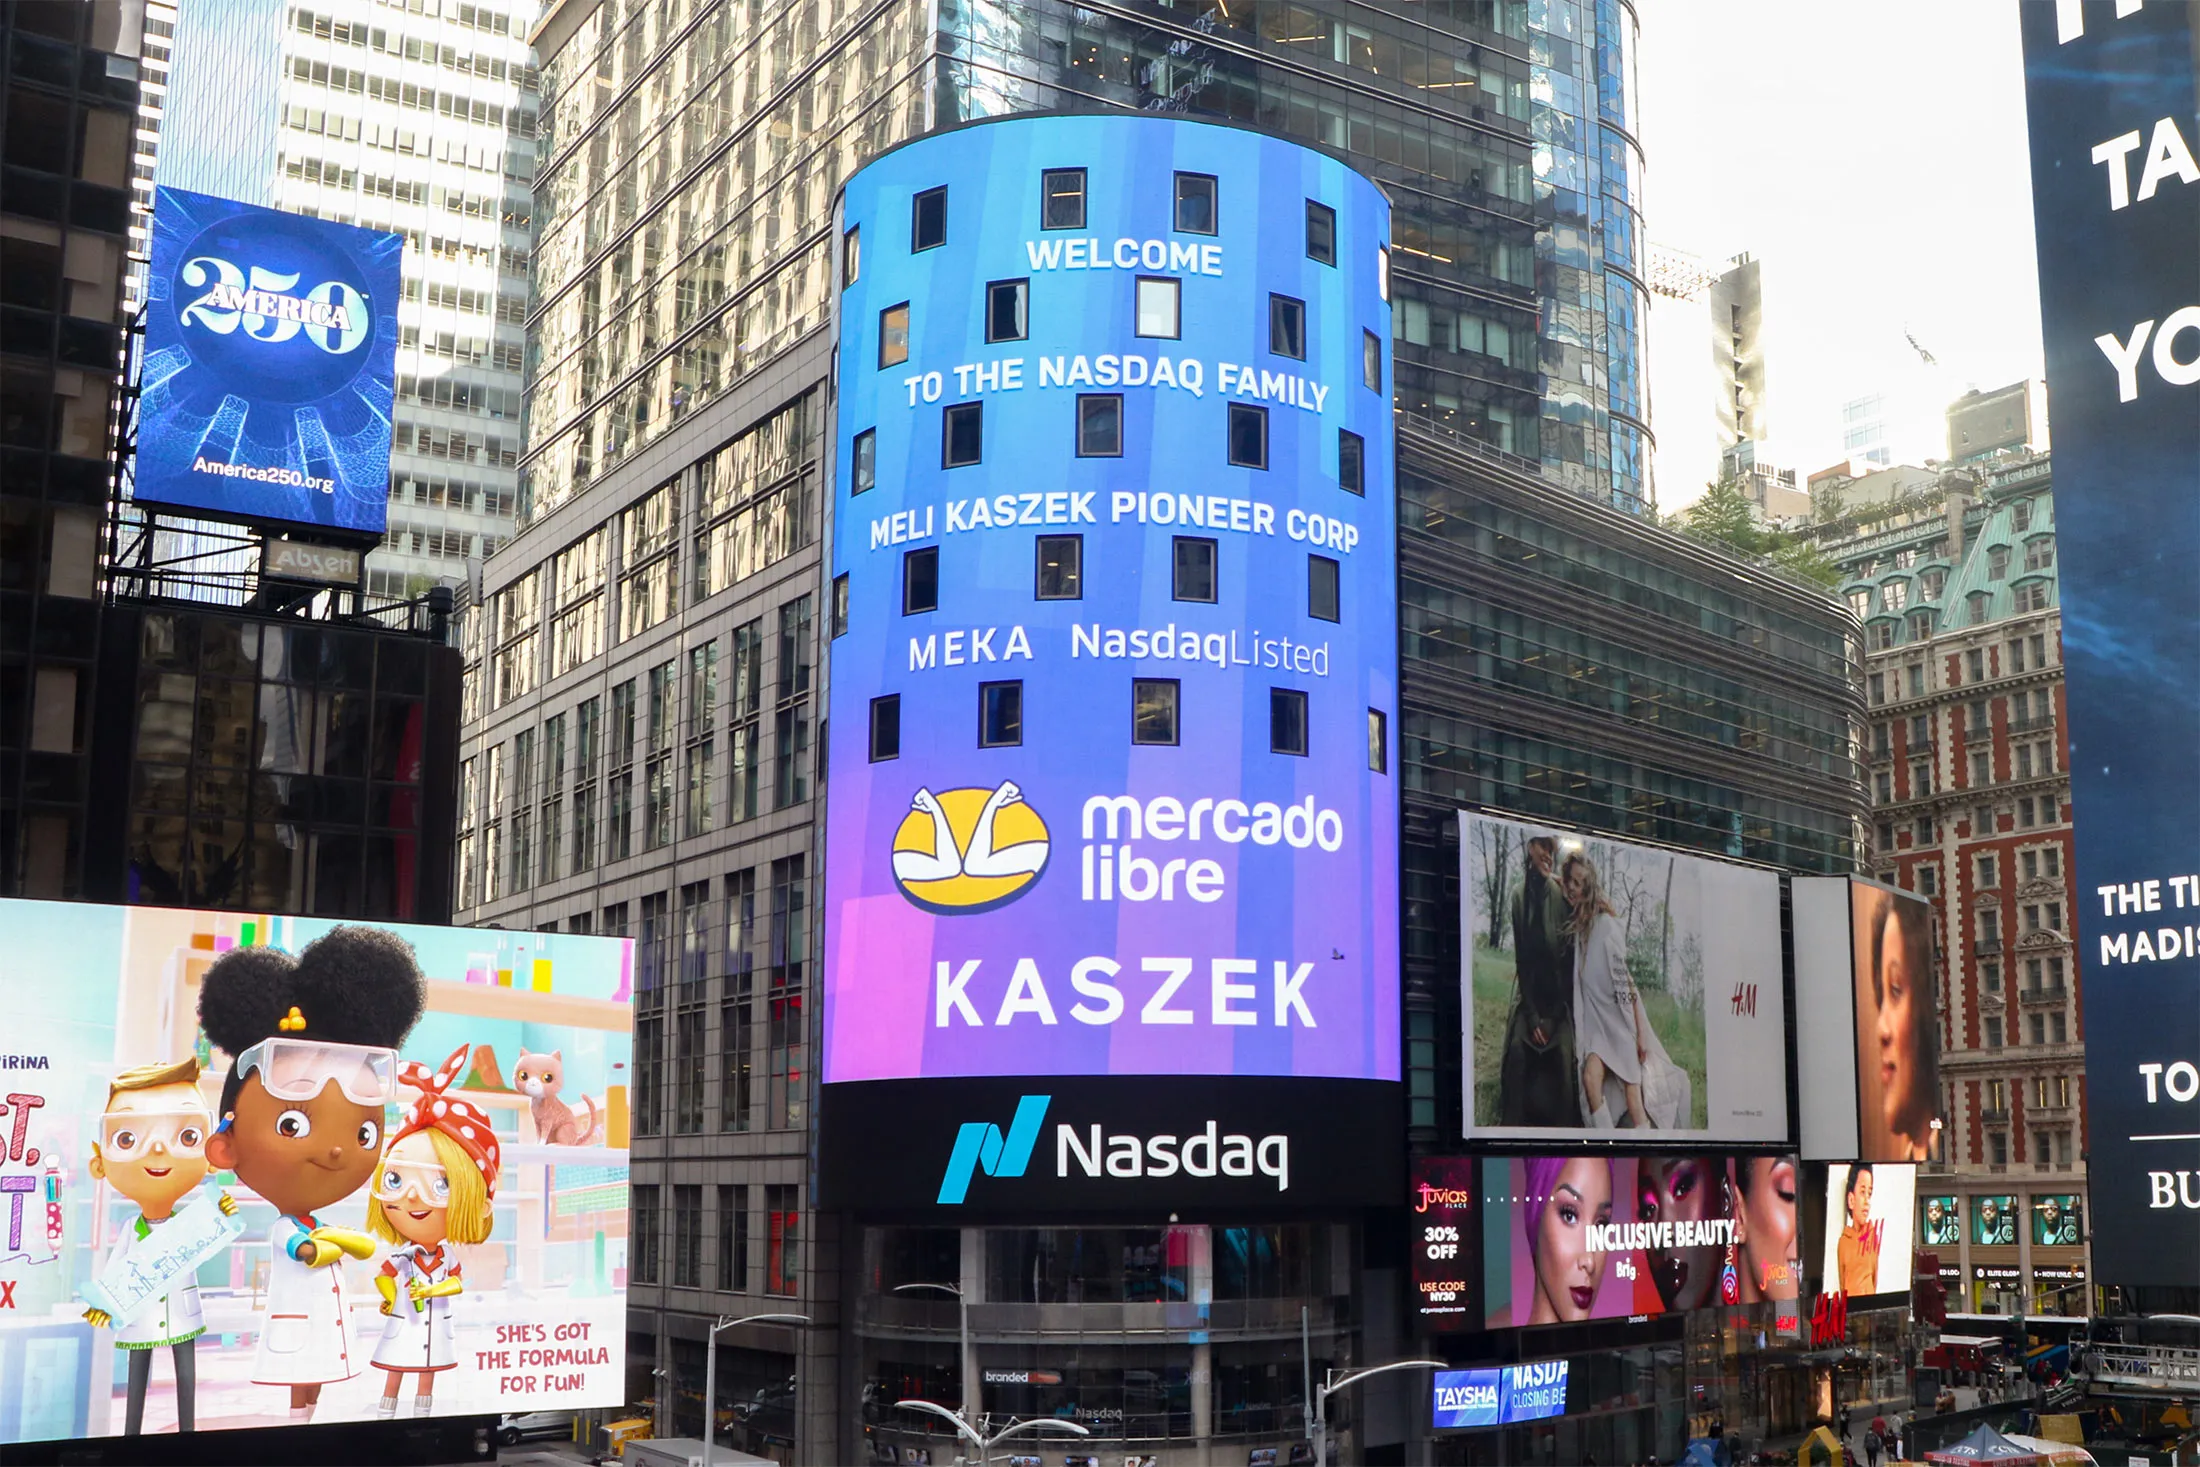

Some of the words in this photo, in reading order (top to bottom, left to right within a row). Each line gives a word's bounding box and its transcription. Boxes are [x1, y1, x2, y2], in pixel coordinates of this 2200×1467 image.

[1026, 238, 1223, 276] WELCOME
[180, 256, 370, 355] 250
[206, 282, 353, 331] AMERICA
[904, 370, 943, 408] TO
[953, 357, 1024, 397] THE
[1038, 354, 1204, 397] NASDAQ
[1217, 363, 1329, 413] FAMILY
[193, 456, 335, 494] America250.org
[870, 503, 934, 551] MELI
[945, 491, 1097, 533] KASZEK
[1110, 492, 1274, 537] PIONEER
[1286, 509, 1360, 554] CORP
[909, 625, 1034, 672] MEKA
[1081, 794, 1343, 852] mercado
[1081, 845, 1225, 903] libre
[2097, 880, 2161, 917] THE
[2100, 926, 2200, 966] MADI
[935, 956, 1318, 1029] KASZEK
[1731, 982, 1758, 1018] H&M
[0, 1055, 50, 1070] iRiNA
[2139, 1061, 2200, 1103] TO
[1056, 1120, 1289, 1193] Nasdaq
[1424, 1226, 1459, 1242] 30%
[1427, 1244, 1458, 1260] OFF
[1585, 1221, 1673, 1252] INCLUSIVE
[1675, 1219, 1739, 1248] BEAUTY.
[1420, 1282, 1437, 1292] USE
[1438, 1281, 1466, 1291] CODE
[1430, 1292, 1456, 1302] NY30
[496, 1324, 547, 1344] SHE'S
[554, 1322, 592, 1341] GOT
[476, 1351, 511, 1371] THE
[519, 1347, 610, 1368] FORMULA
[985, 1371, 1029, 1383] branded
[500, 1375, 537, 1394] FOR
[544, 1373, 585, 1392] FUN!
[1435, 1385, 1498, 1406] TAYSHA
[1513, 1390, 1549, 1408] CLOSING
[1075, 1407, 1122, 1421] Nasdaq
